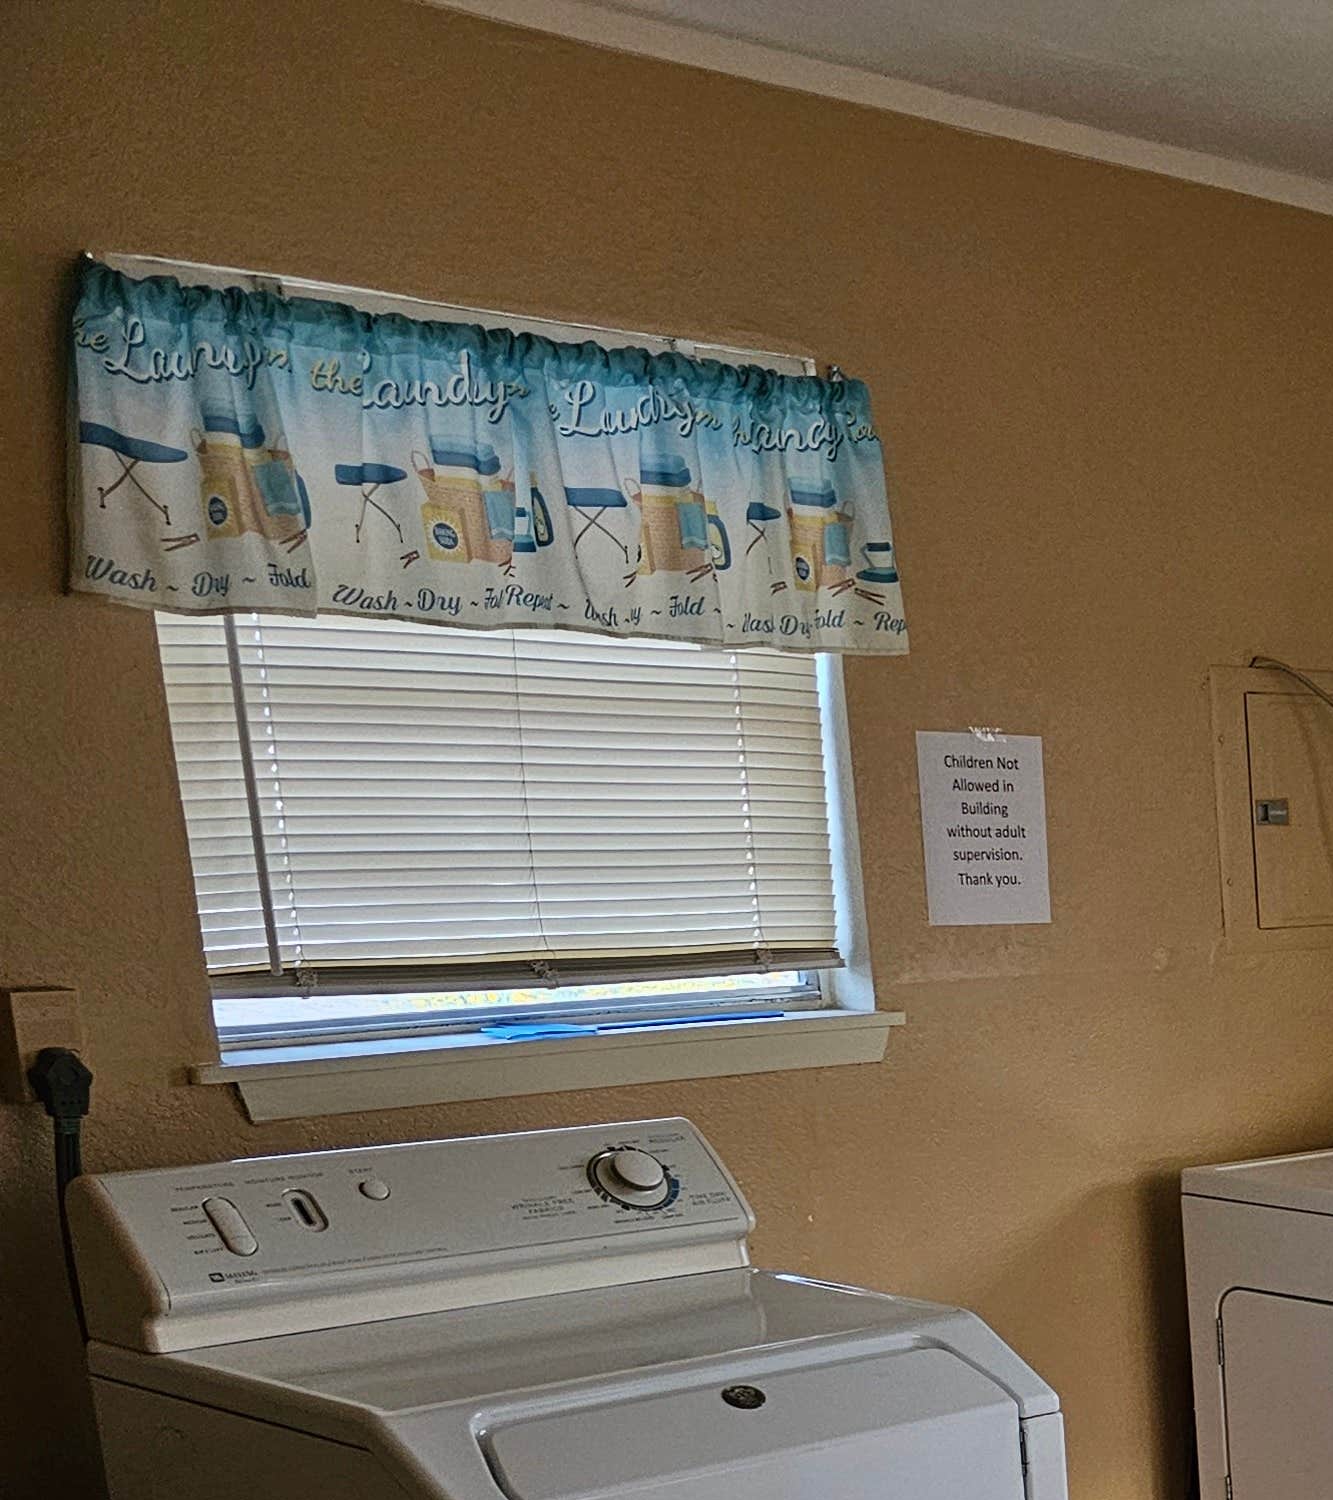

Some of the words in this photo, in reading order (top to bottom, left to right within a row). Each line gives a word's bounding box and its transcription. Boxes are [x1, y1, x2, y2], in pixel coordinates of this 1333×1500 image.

[85, 554, 158, 592] Wash
[191, 571, 230, 597] Dry
[267, 563, 312, 589] Fold
[332, 584, 398, 612] Wash
[418, 588, 461, 616] Dry
[484, 588, 504, 610] Fol
[669, 595, 706, 617] Fold
[944, 755, 993, 769] Children
[996, 757, 1019, 771] Not
[952, 779, 999, 792] Allowed
[1003, 779, 1014, 792] in
[961, 802, 1009, 818] Building
[947, 825, 992, 839] without
[995, 825, 1026, 839] adult
[953, 848, 1023, 863] supervision.
[958, 873, 993, 886] Thank
[995, 875, 1021, 888] you.
